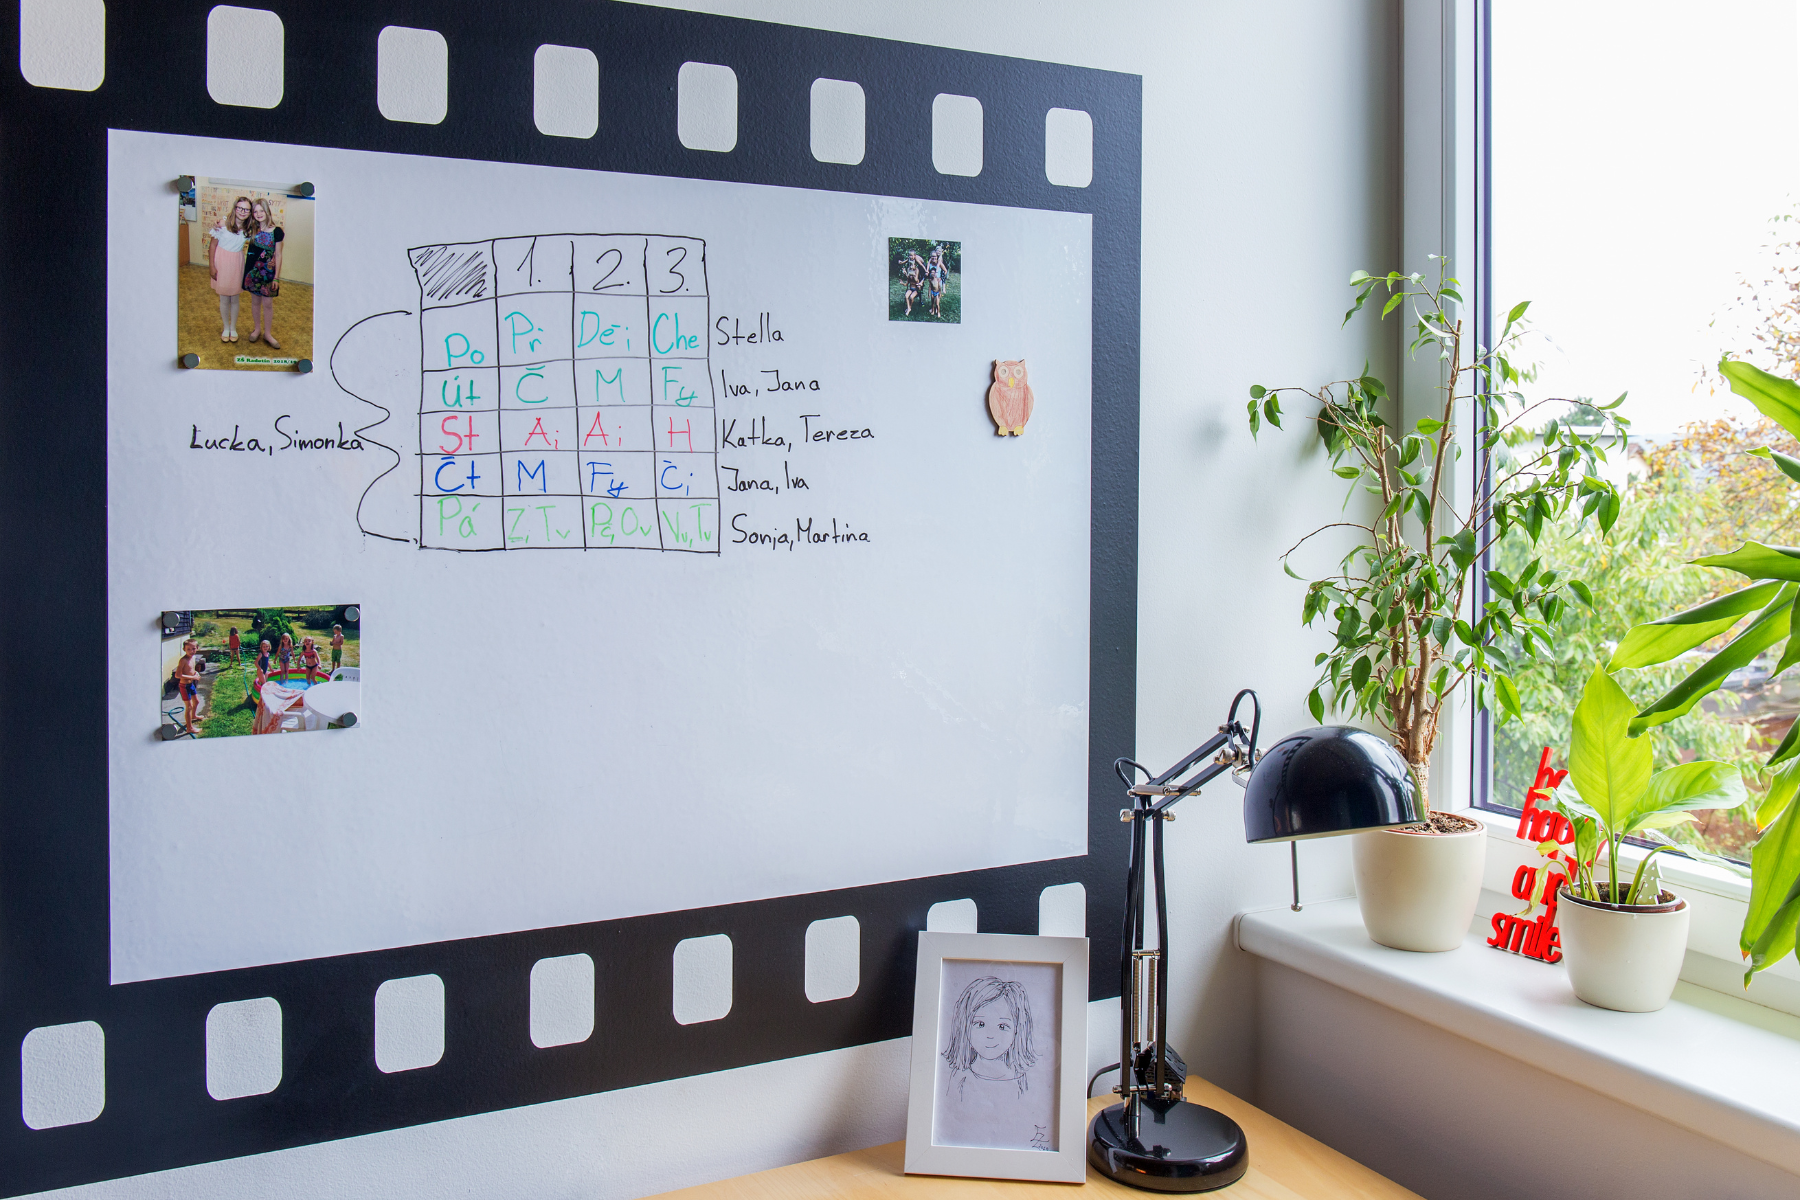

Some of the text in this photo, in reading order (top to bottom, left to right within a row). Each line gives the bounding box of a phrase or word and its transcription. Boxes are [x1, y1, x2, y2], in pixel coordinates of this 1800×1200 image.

[593, 249, 630, 290] 2.
[660, 247, 689, 293] 3.
[445, 333, 484, 367] Po
[652, 313, 699, 354] Che
[716, 312, 784, 345] Stella
[595, 368, 625, 402] M
[662, 366, 698, 407] Fy
[439, 415, 480, 454] St
[668, 416, 693, 453] H
[800, 414, 875, 443] Tereza
[518, 460, 546, 493] M
[586, 461, 629, 498] Fy
[1487, 904, 1563, 963] smile
